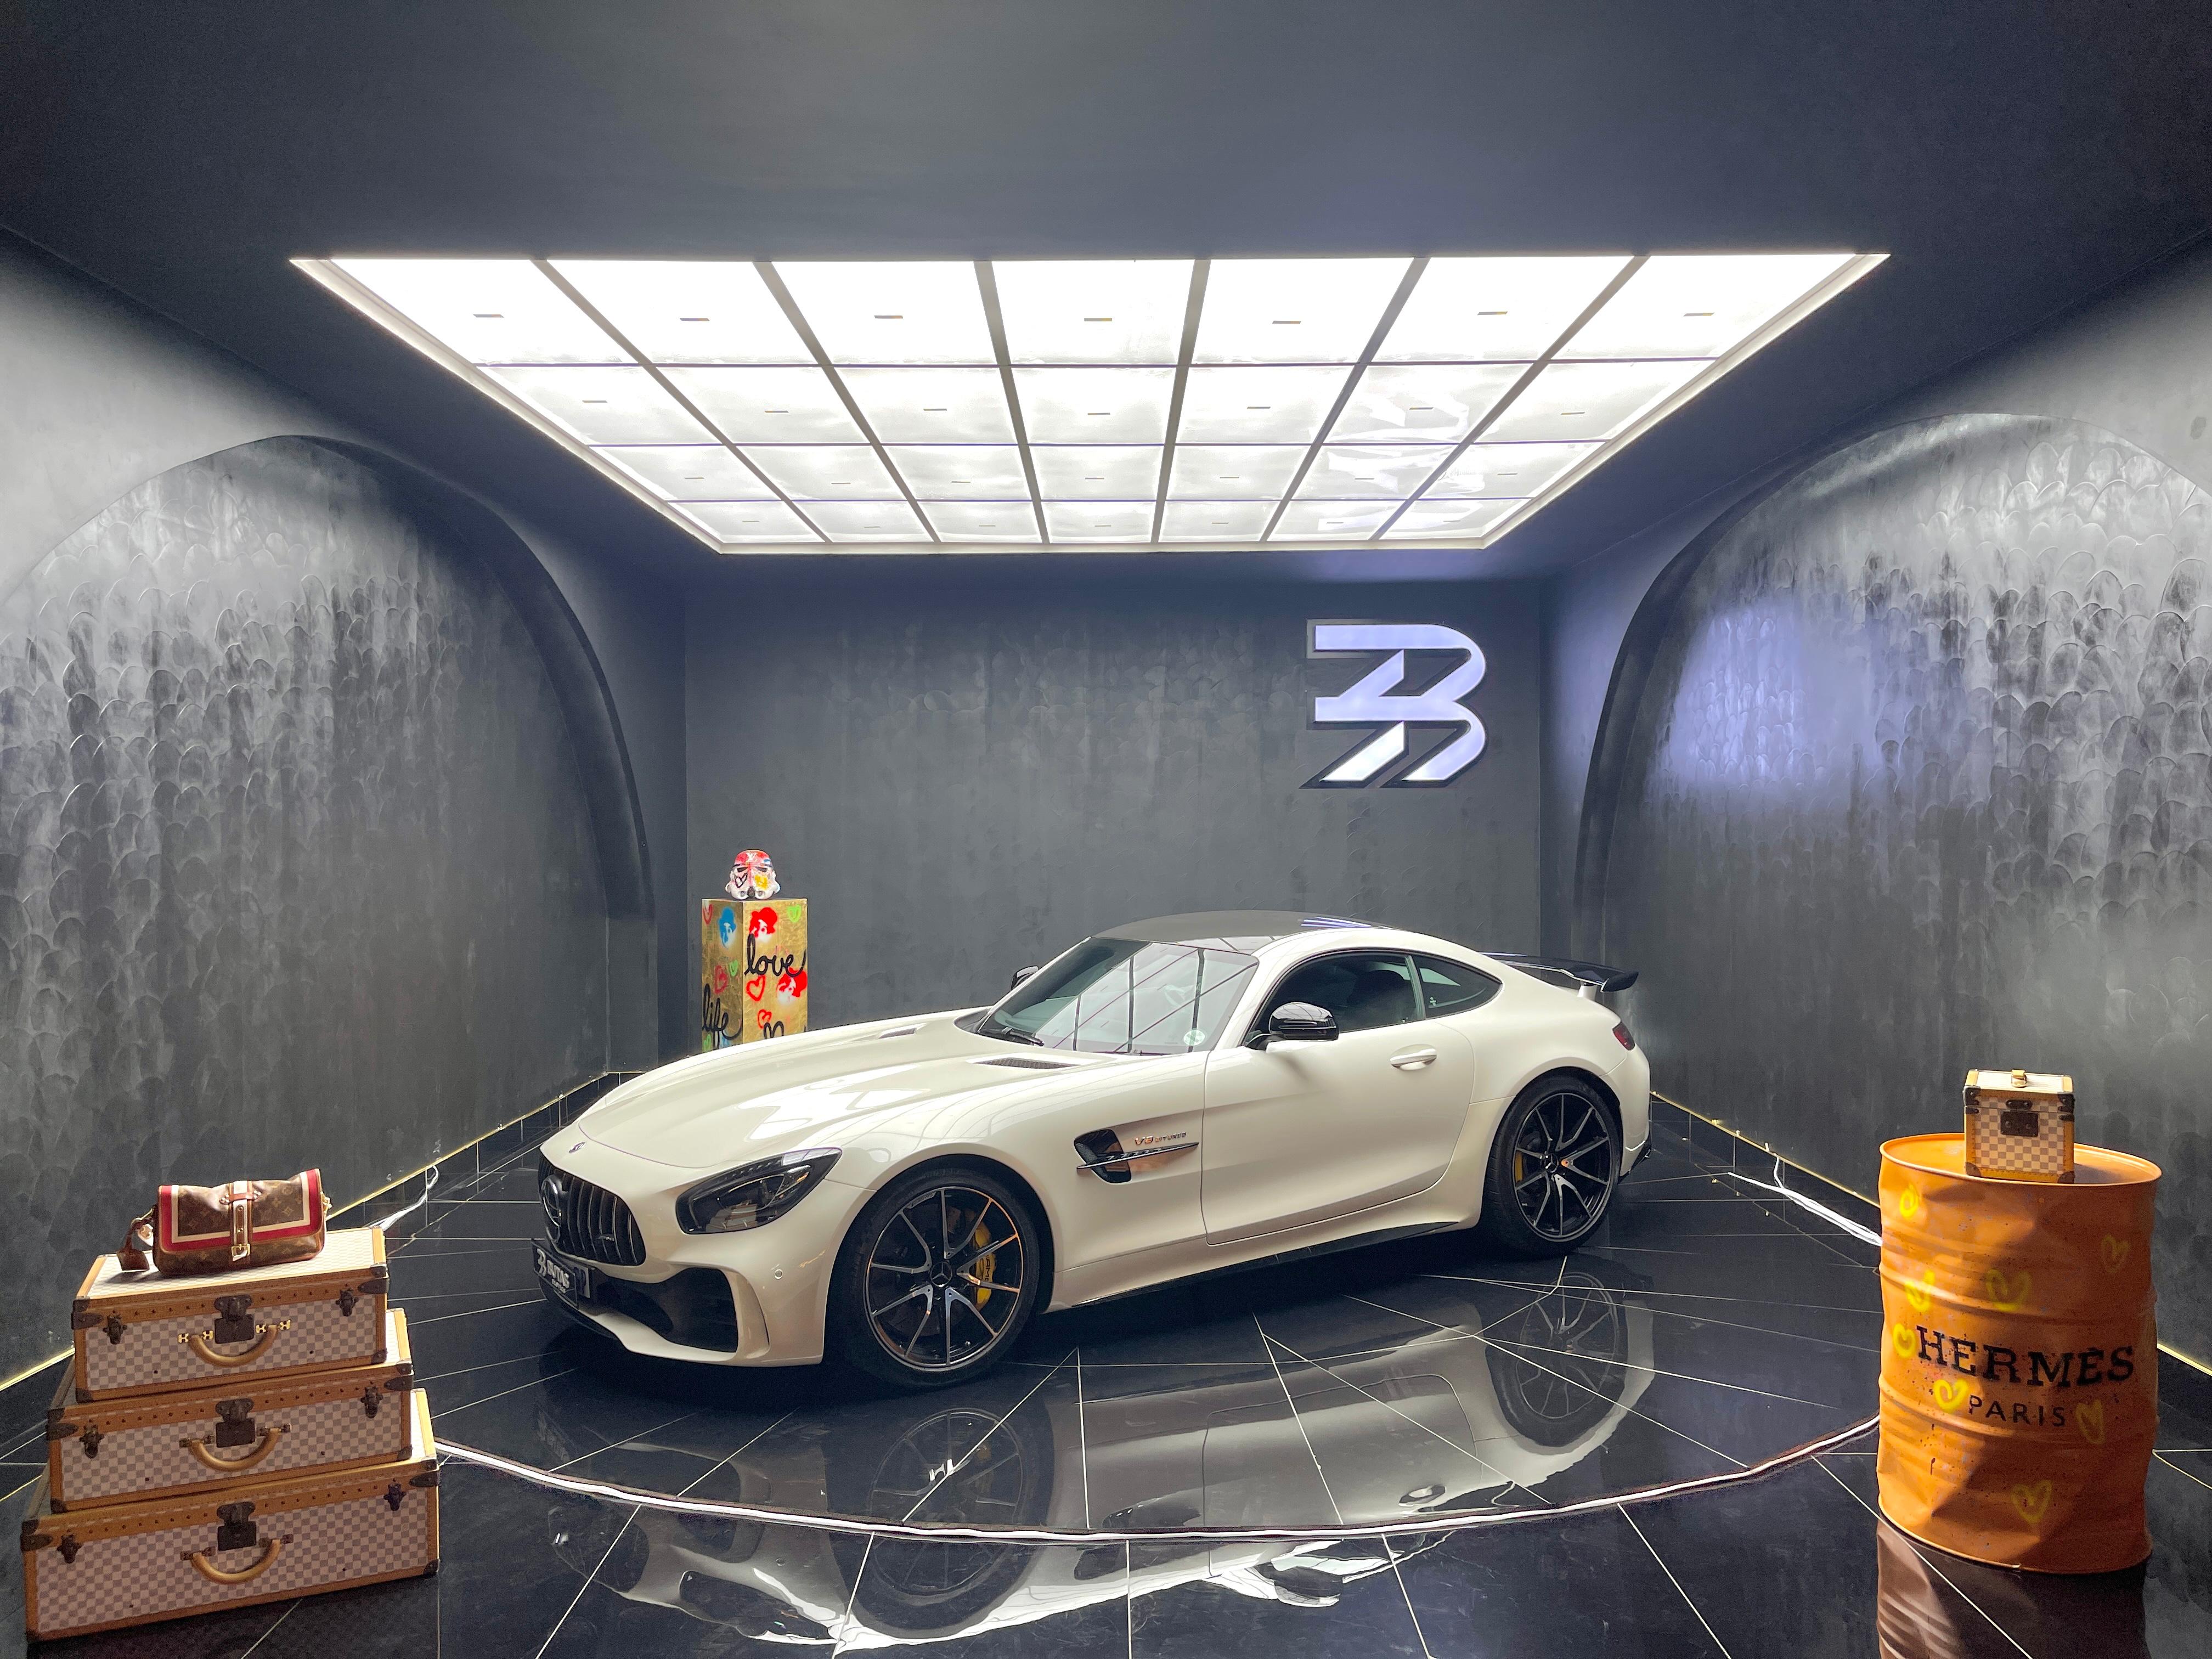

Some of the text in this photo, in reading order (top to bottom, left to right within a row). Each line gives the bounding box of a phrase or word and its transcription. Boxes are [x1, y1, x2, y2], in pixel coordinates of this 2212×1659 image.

[744, 933, 806, 977] love
[702, 983, 742, 1049] life
[1135, 1136, 1153, 1146] V8
[1968, 1395, 2066, 1427] PARIS
